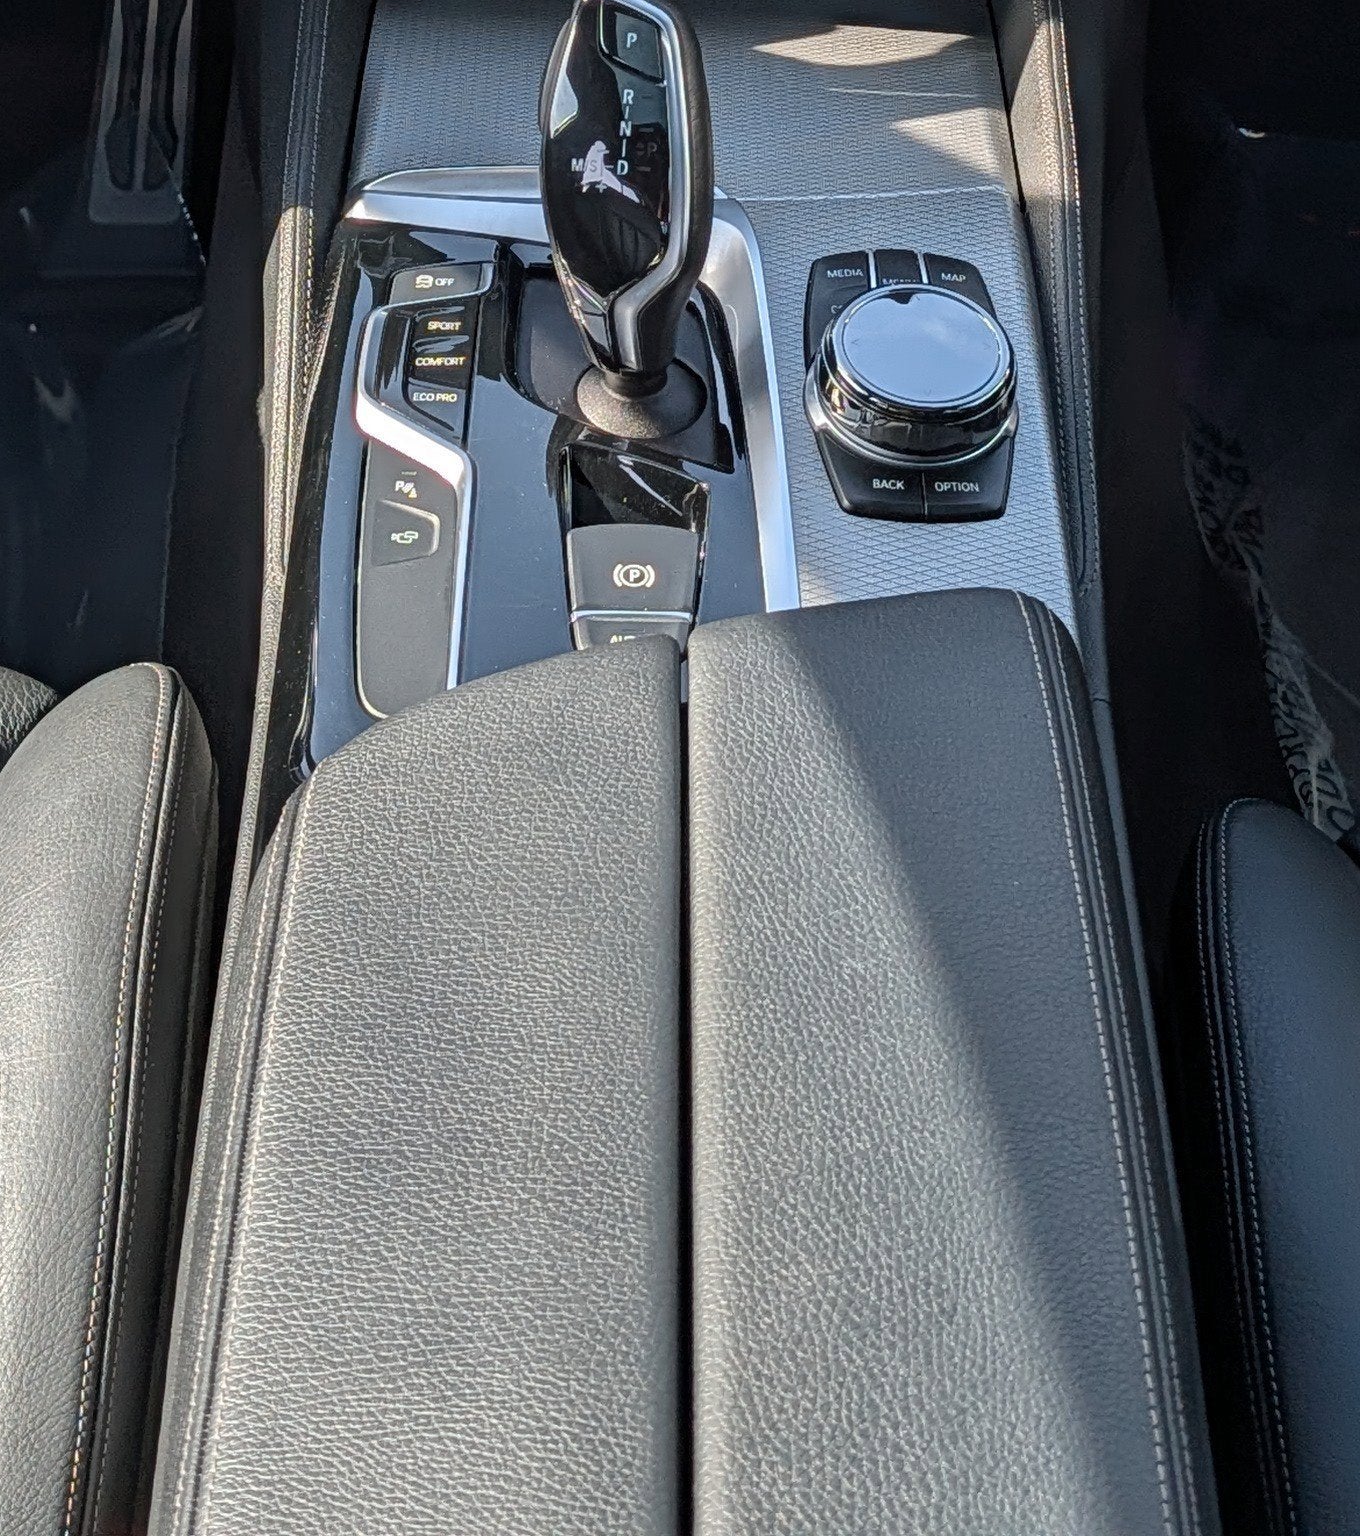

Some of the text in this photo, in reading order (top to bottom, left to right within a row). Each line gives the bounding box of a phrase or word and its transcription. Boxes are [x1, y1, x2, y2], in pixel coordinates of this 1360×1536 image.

[626, 32, 638, 49] P
[622, 88, 635, 105] R
[619, 120, 632, 137] N
[616, 159, 629, 176] D
[826, 268, 865, 280] MEDIA
[940, 271, 967, 283] MAP
[434, 277, 455, 287] OFF
[427, 321, 462, 332] SPORT
[414, 356, 466, 367] COMFORT
[412, 392, 458, 403] ECO PRO
[871, 477, 906, 491] BACK
[934, 481, 980, 493] OPTION
